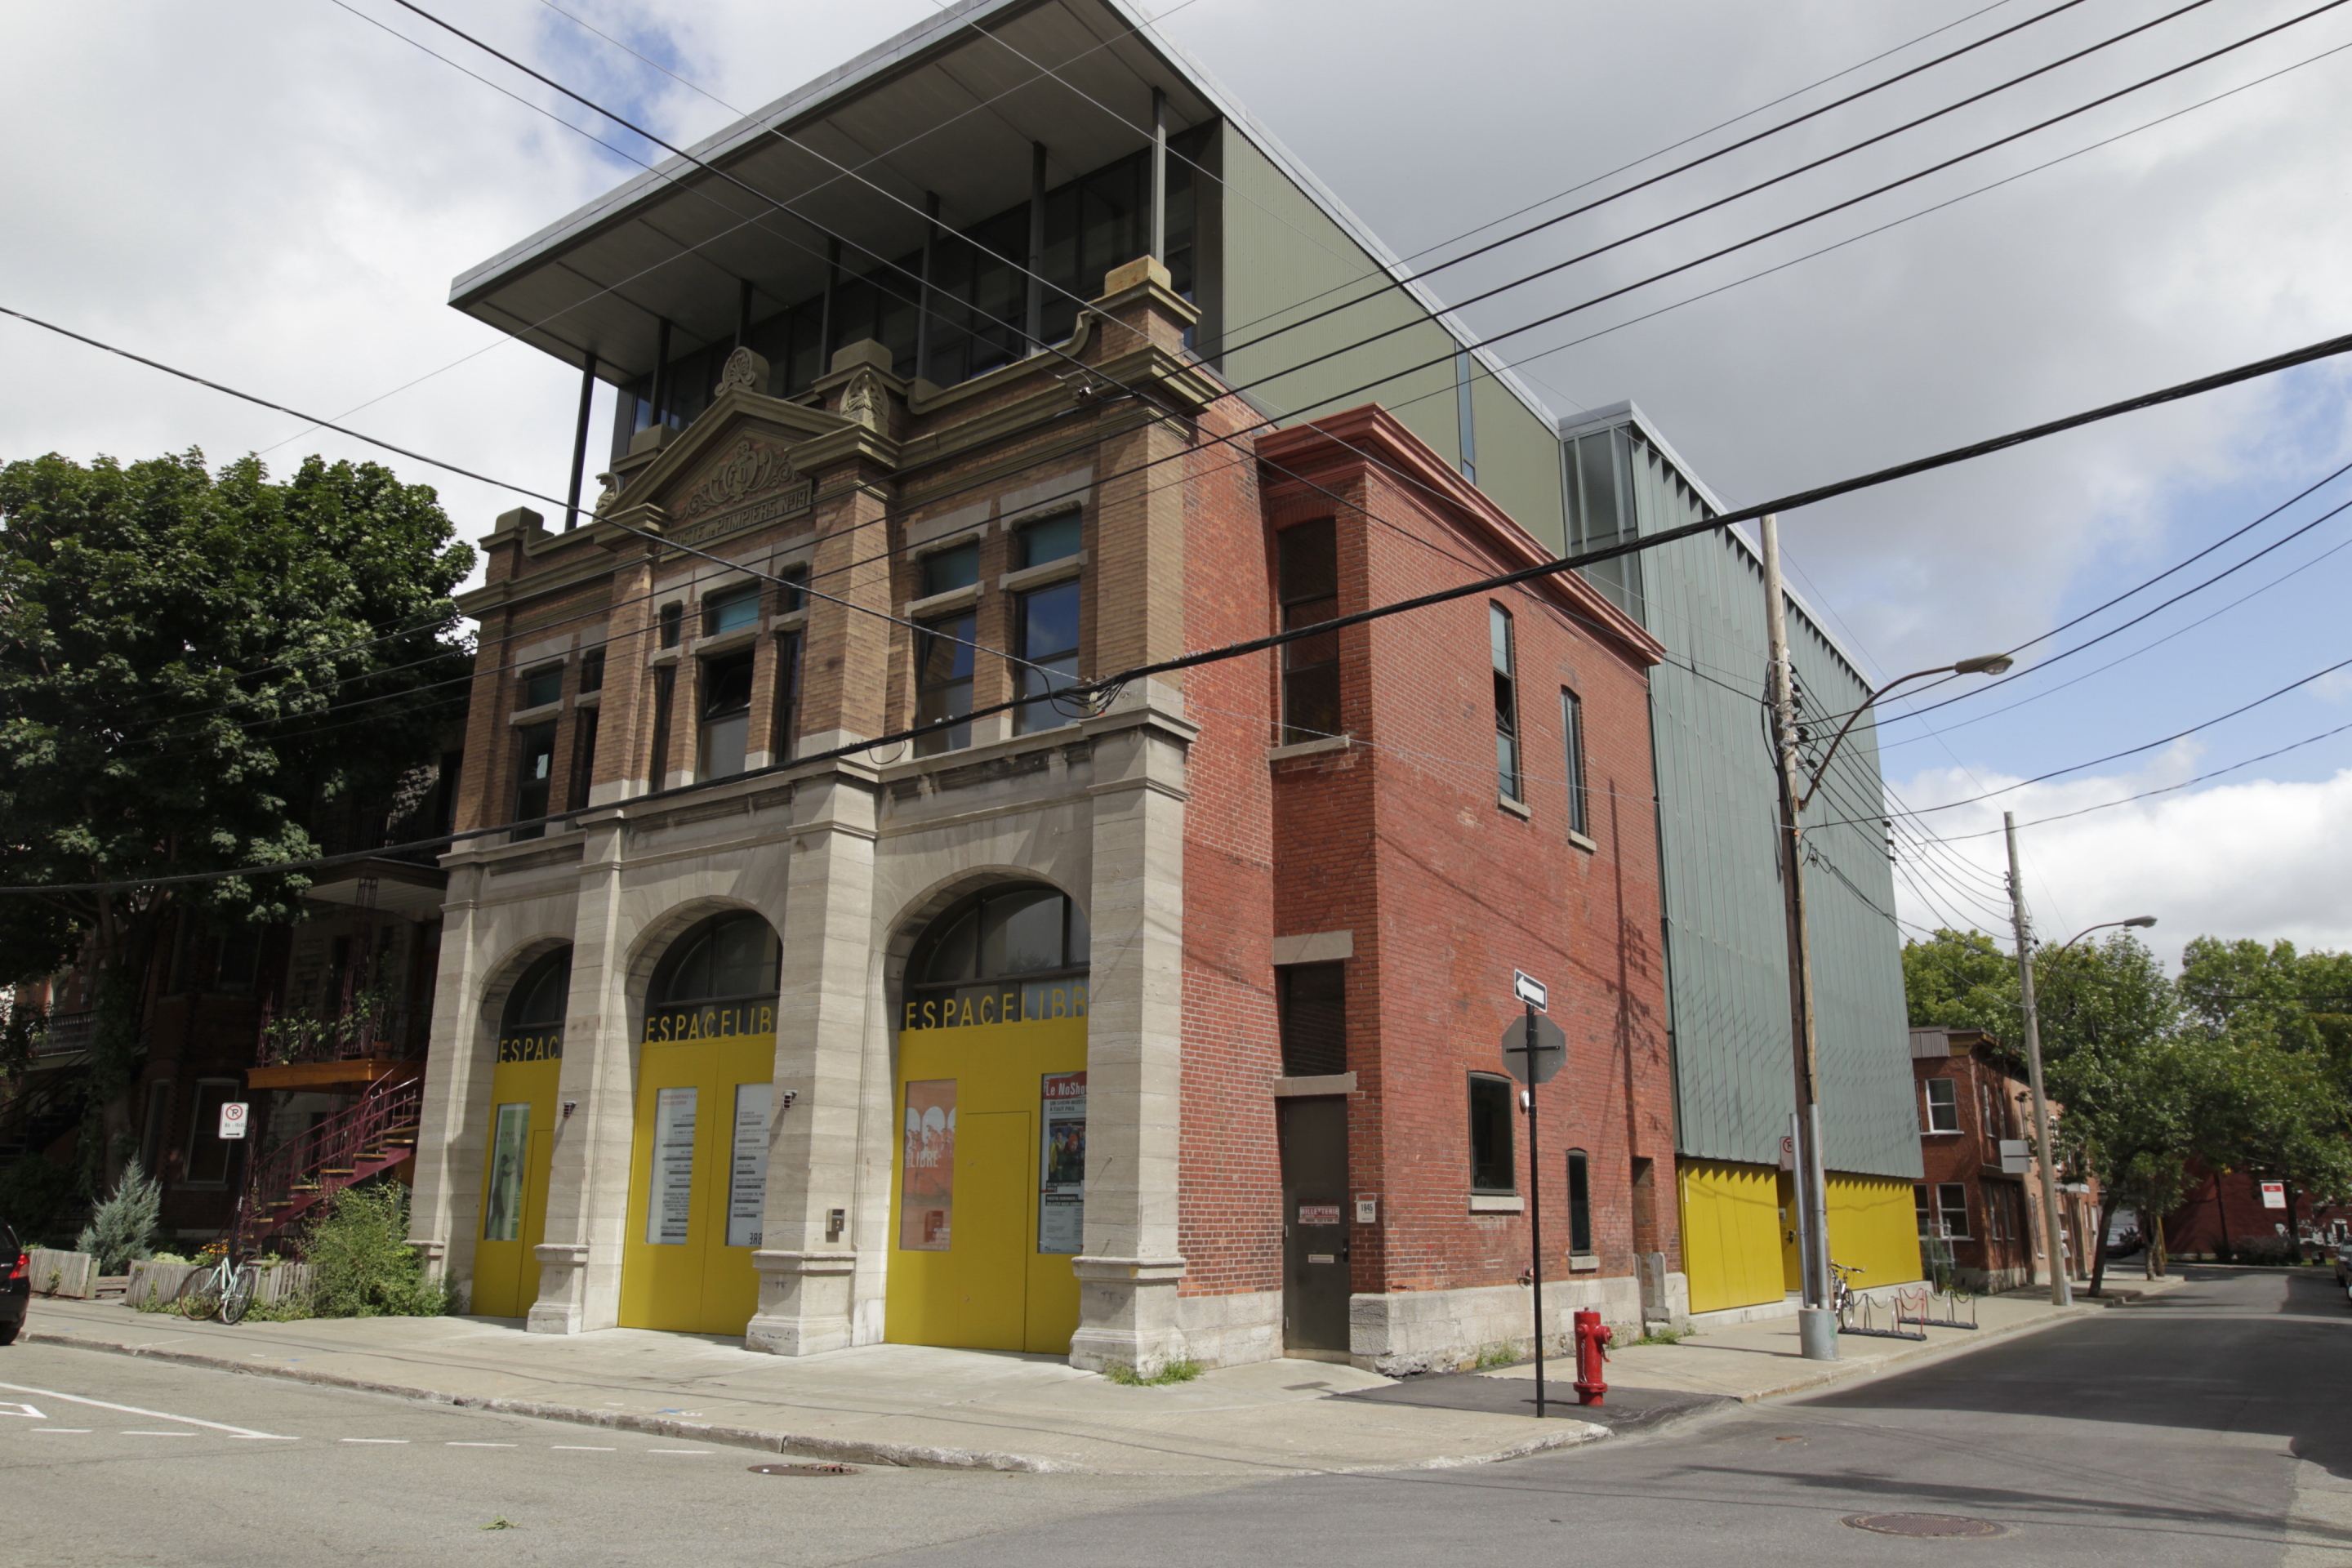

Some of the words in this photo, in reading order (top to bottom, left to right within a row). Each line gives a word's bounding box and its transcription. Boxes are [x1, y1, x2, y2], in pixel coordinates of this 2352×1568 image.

[717, 501, 777, 537] POMPIERS
[500, 1036, 559, 1063] ESPAC
[1045, 1081, 1056, 1097] Le
[1058, 1081, 1087, 1096] NoSho
[910, 1150, 938, 1168] LIBRE
[1361, 1203, 1374, 1212] 1945
